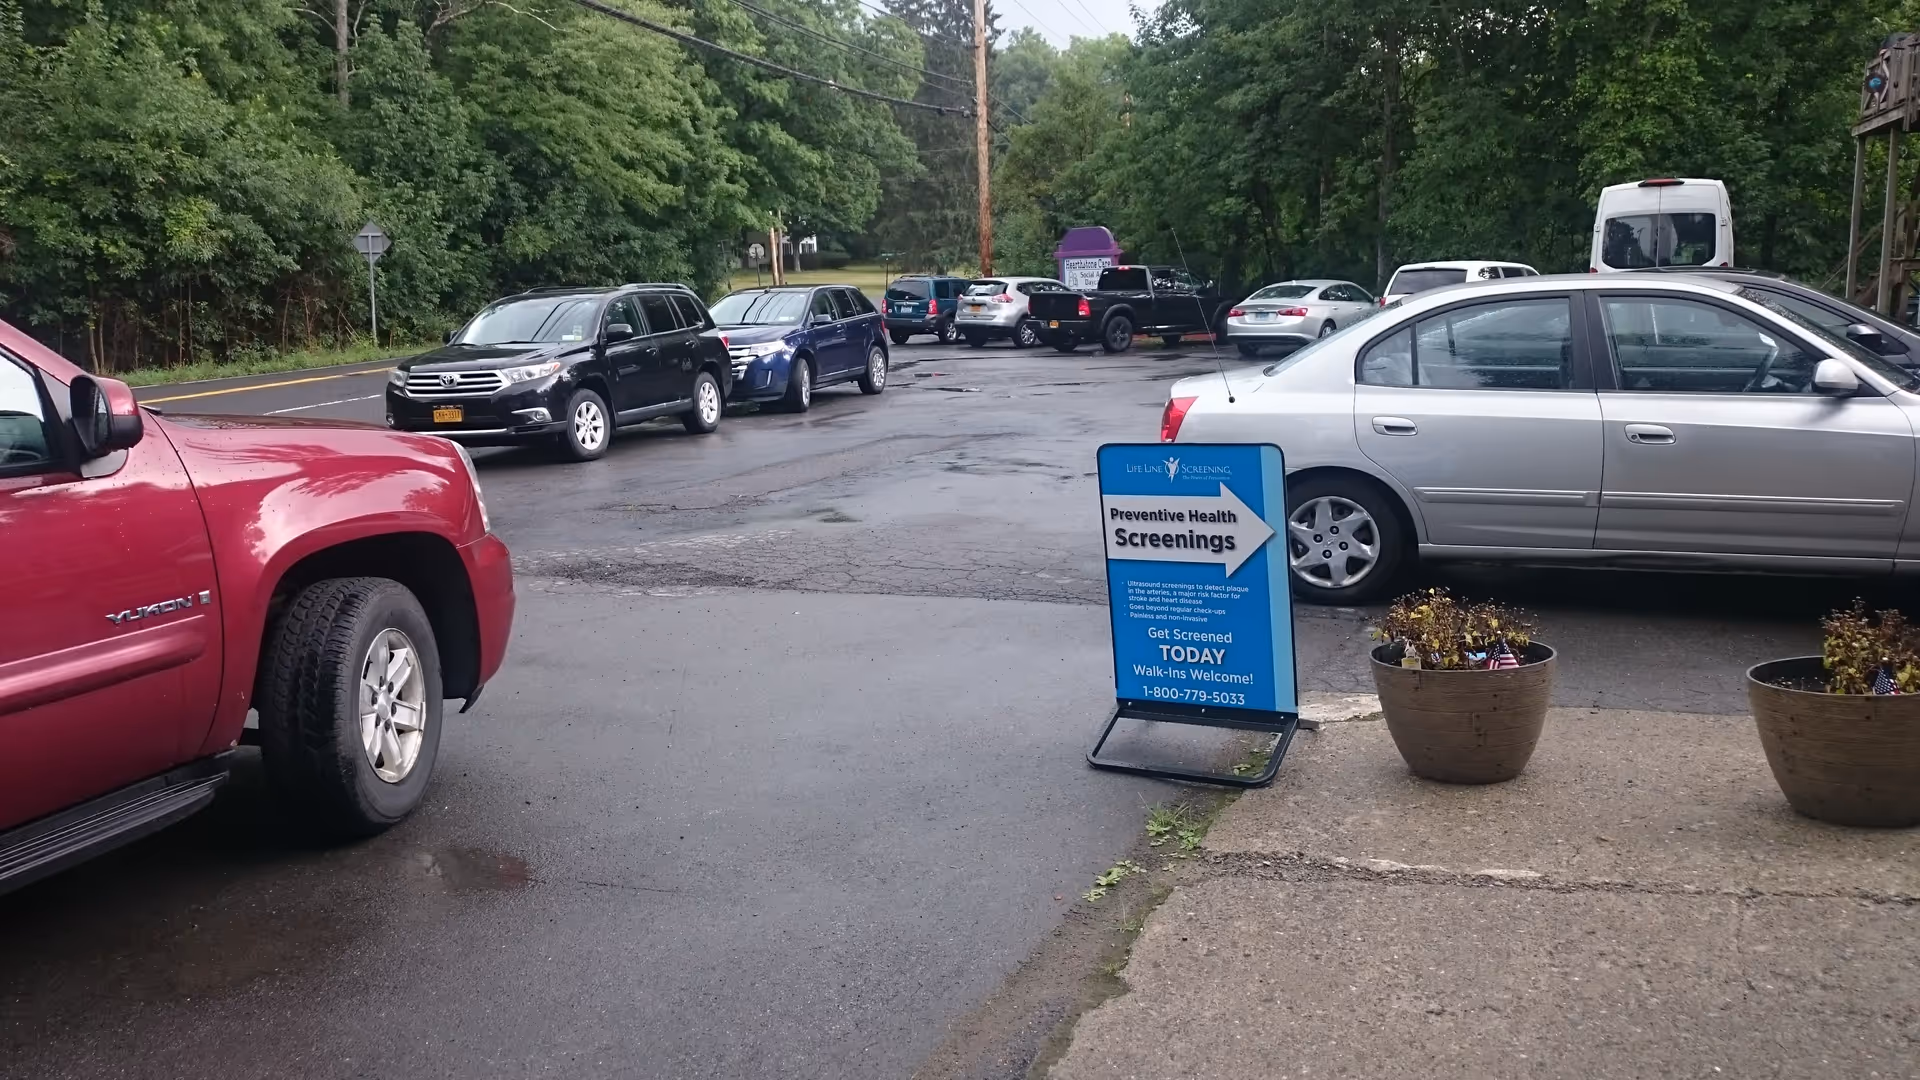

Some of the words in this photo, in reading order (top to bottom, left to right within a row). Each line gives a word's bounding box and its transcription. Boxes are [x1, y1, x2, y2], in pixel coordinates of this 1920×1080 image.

[1126, 464, 1142, 473] LIFE
[1144, 464, 1163, 473] LINE
[1181, 464, 1232, 474] SCREENING
[1110, 508, 1185, 522] Preventive
[1188, 510, 1237, 524] Health
[1115, 528, 1236, 553] Screenings
[105, 596, 192, 624] YUKON
[1146, 604, 1168, 612] beyond
[1148, 627, 1170, 639] Get
[1174, 629, 1232, 644] Screened
[1159, 645, 1226, 664] TODAY
[1133, 664, 1186, 679] Walk-Ins
[1190, 669, 1254, 684] Welcome!
[1143, 686, 1245, 705] 1-800-779-5033
